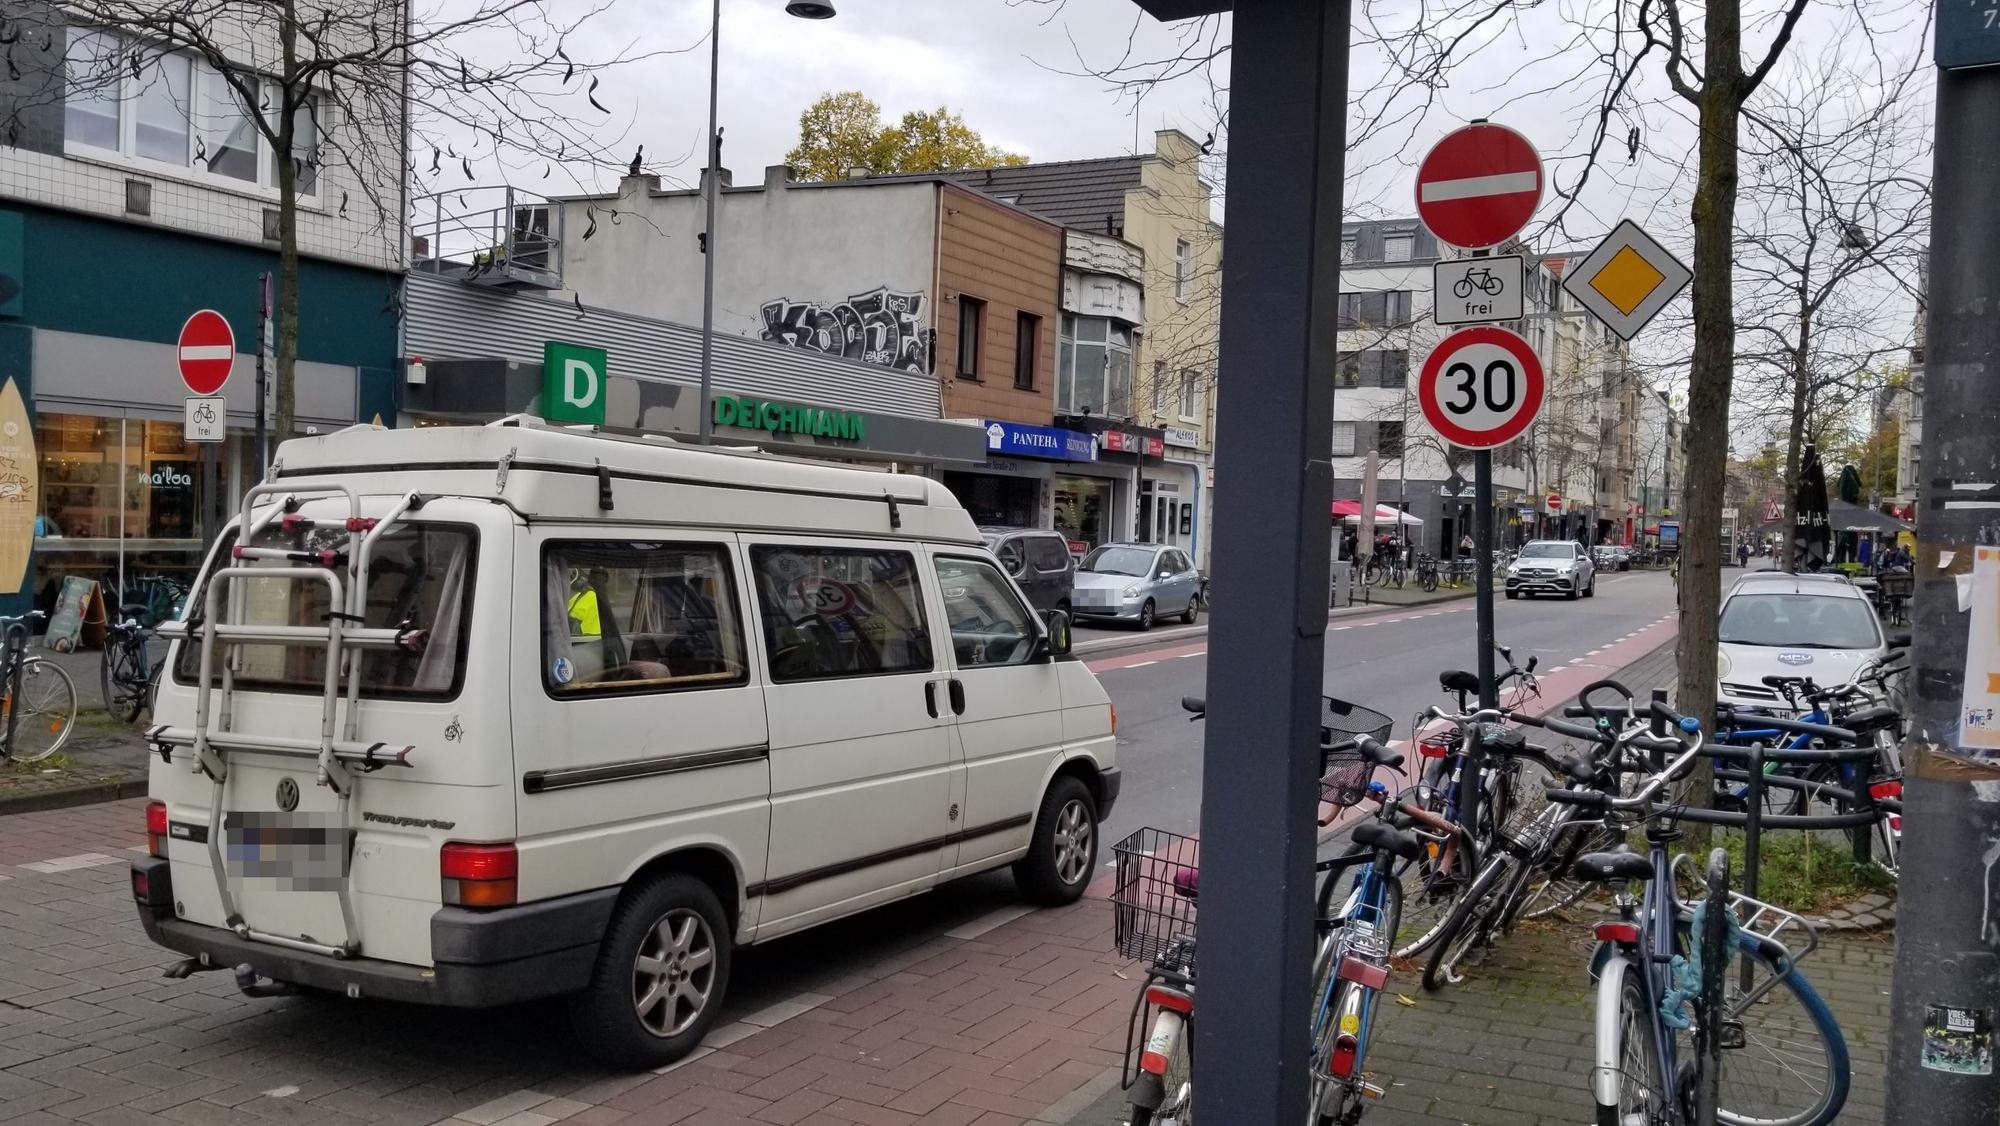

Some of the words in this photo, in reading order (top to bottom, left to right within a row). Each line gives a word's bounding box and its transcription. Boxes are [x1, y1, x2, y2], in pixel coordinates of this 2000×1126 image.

[1465, 300, 1493, 316] frei
[564, 358, 598, 409] D
[1445, 359, 1516, 415] 30
[717, 395, 866, 441] DEICHMANN
[198, 426, 211, 436] frei
[1013, 431, 1058, 449] PANTEHA
[362, 811, 456, 831] Transporter
